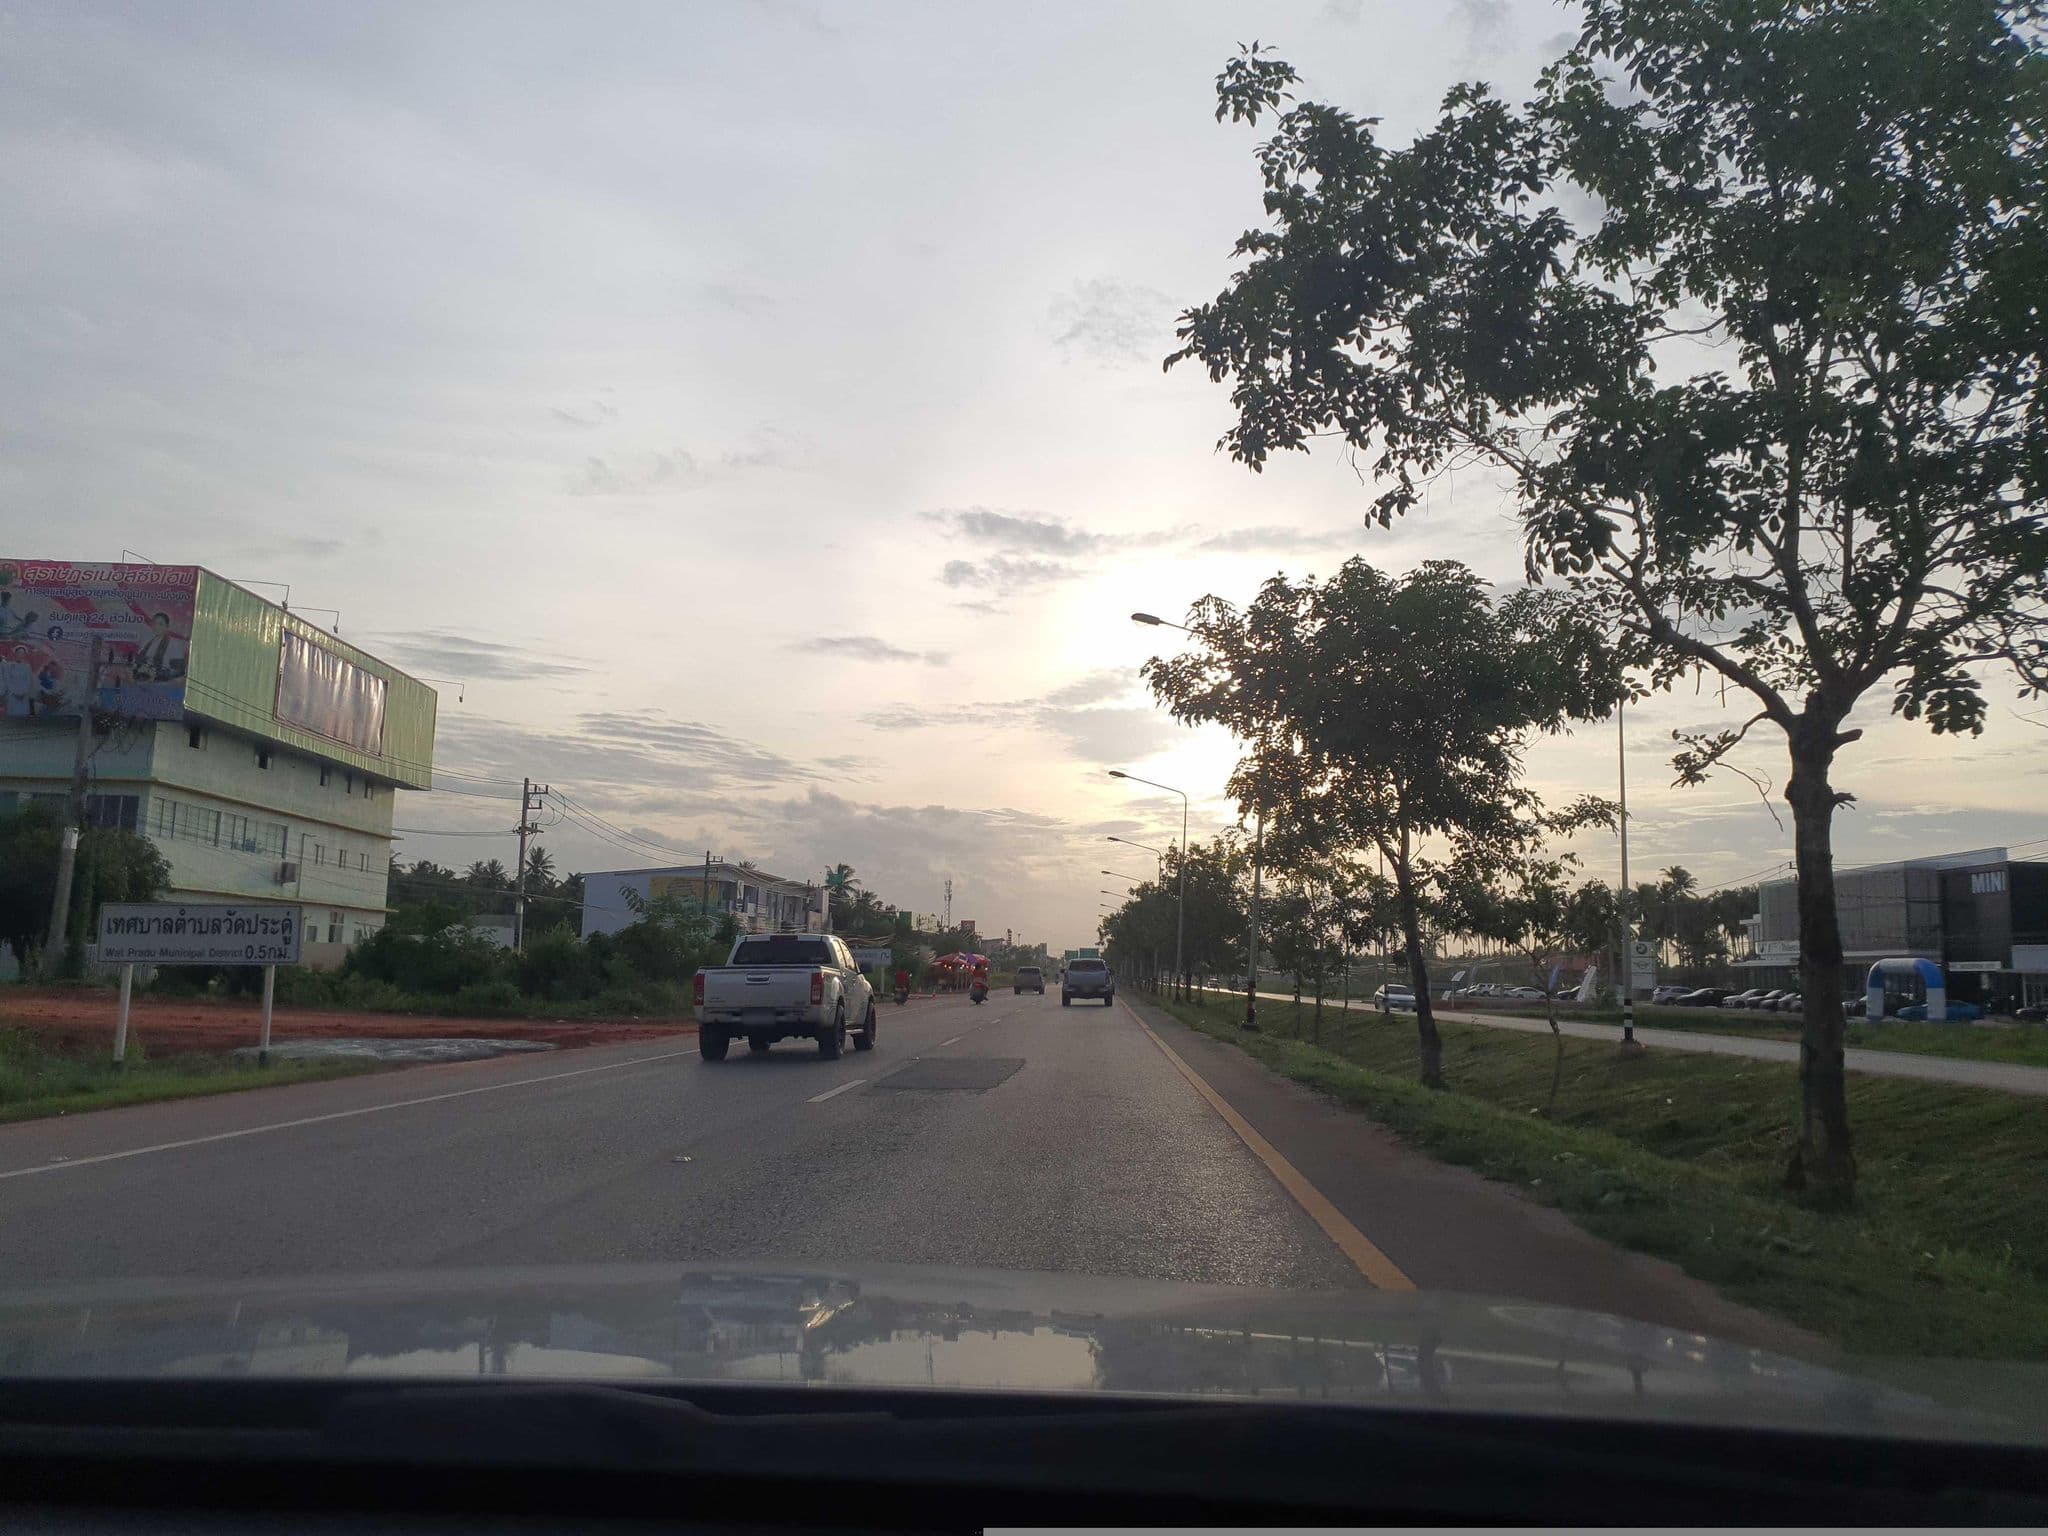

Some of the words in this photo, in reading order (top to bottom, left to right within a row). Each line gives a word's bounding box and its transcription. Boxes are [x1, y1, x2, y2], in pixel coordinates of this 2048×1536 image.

[89, 613, 105, 623] 24
[1971, 871, 2006, 894] MINI
[106, 908, 293, 945] เทศบาลตำบลวัดประดู่
[105, 947, 124, 958] Wat
[160, 947, 205, 959] Municipal
[208, 947, 243, 958] District
